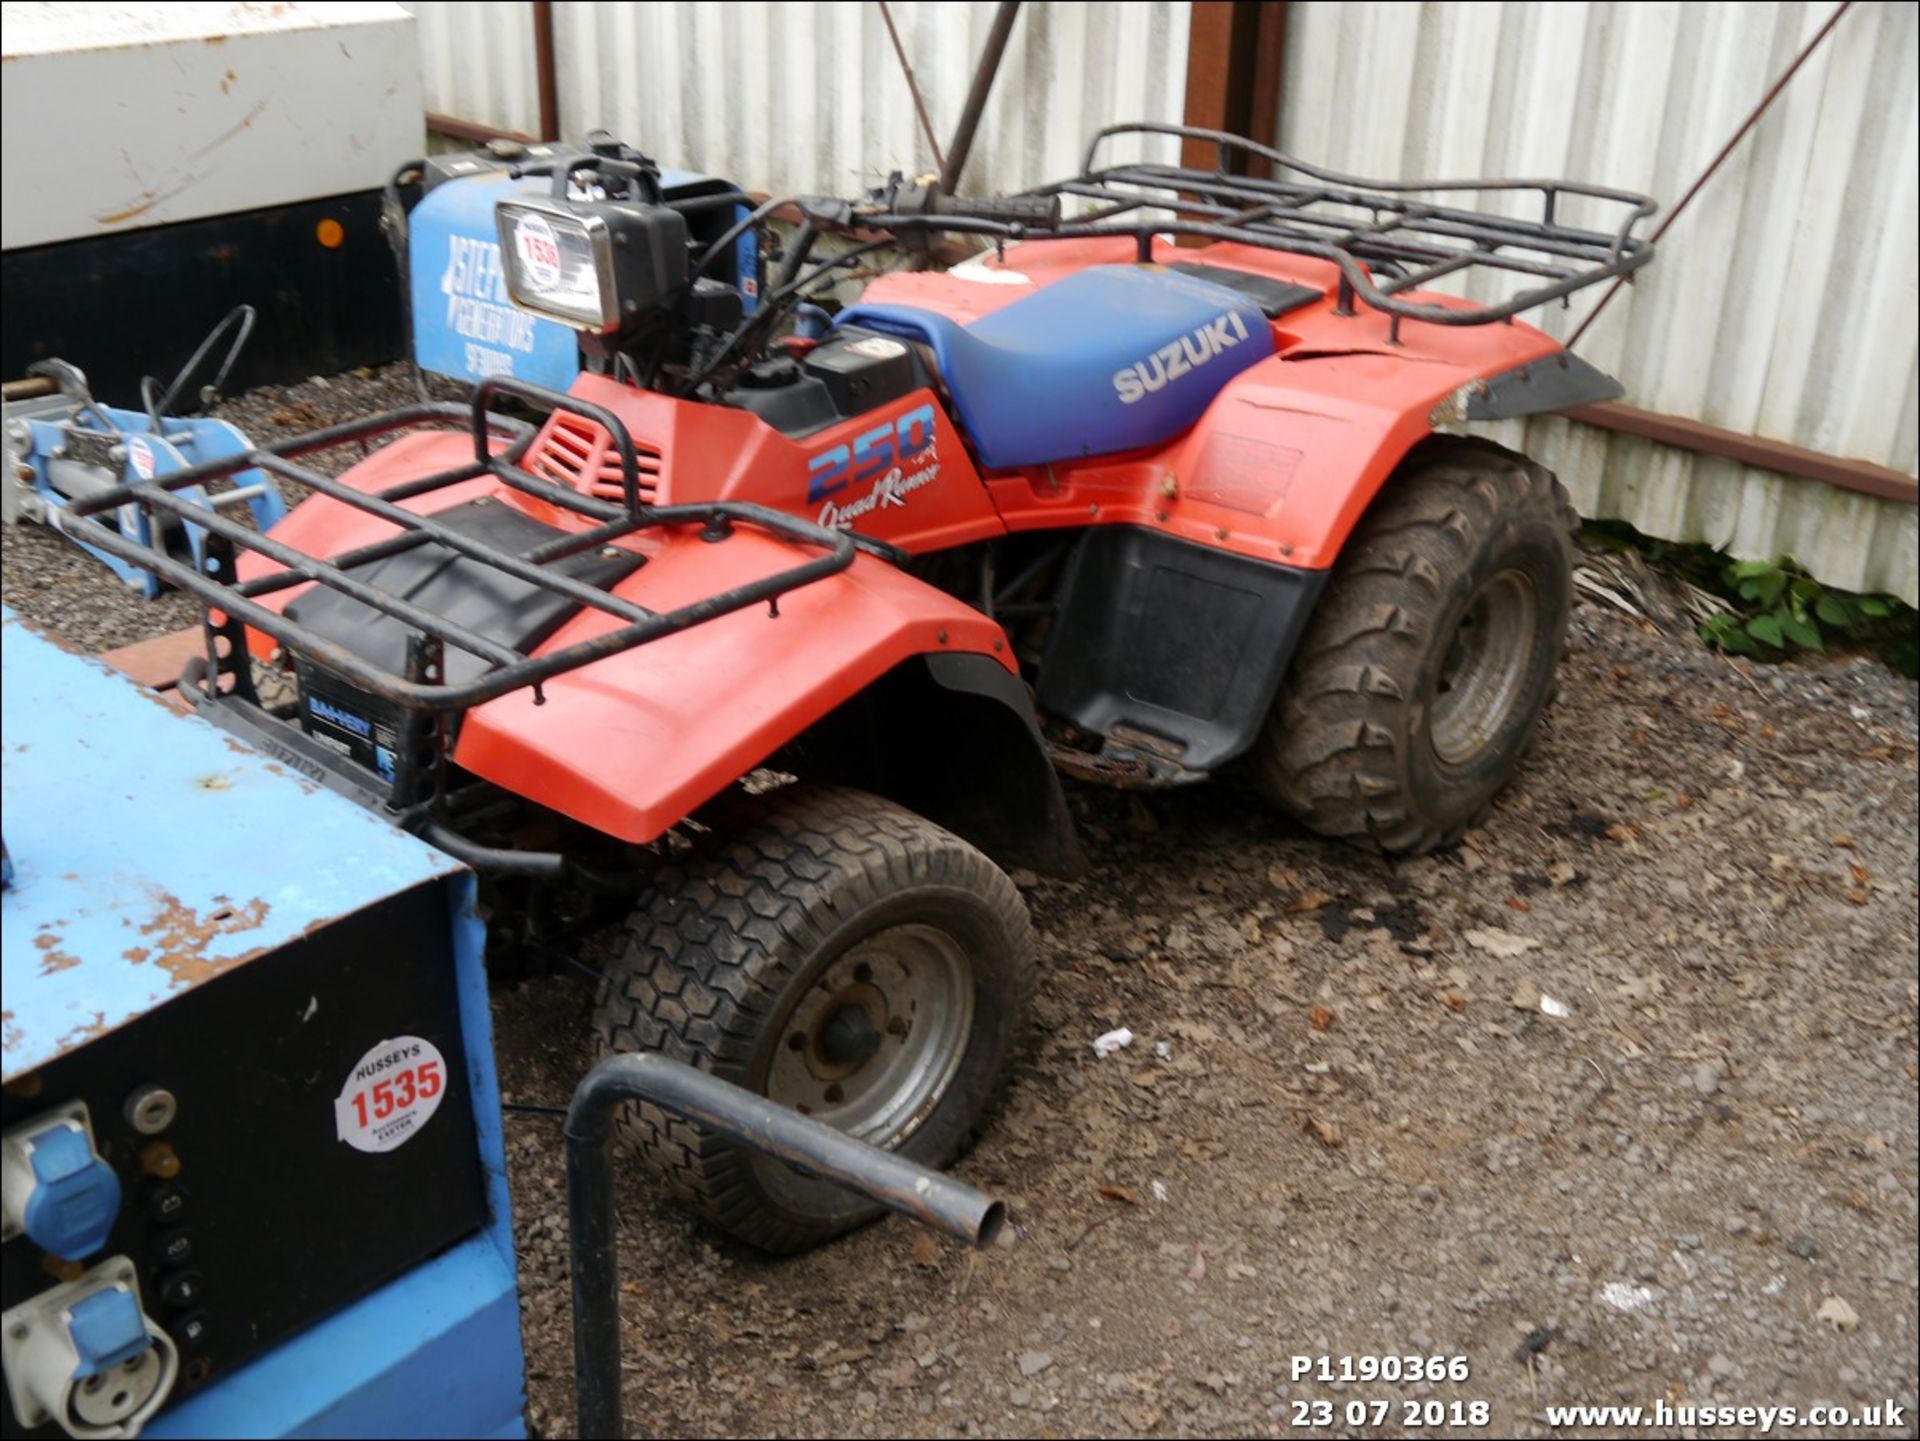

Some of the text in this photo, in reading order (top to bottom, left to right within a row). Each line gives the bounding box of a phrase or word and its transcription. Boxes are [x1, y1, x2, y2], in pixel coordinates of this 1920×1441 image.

[1112, 310, 1249, 404] SUZUKI
[807, 404, 935, 505] 250
[351, 1060, 442, 1128] 1535
[355, 1044, 421, 1081] HUSSEYS
